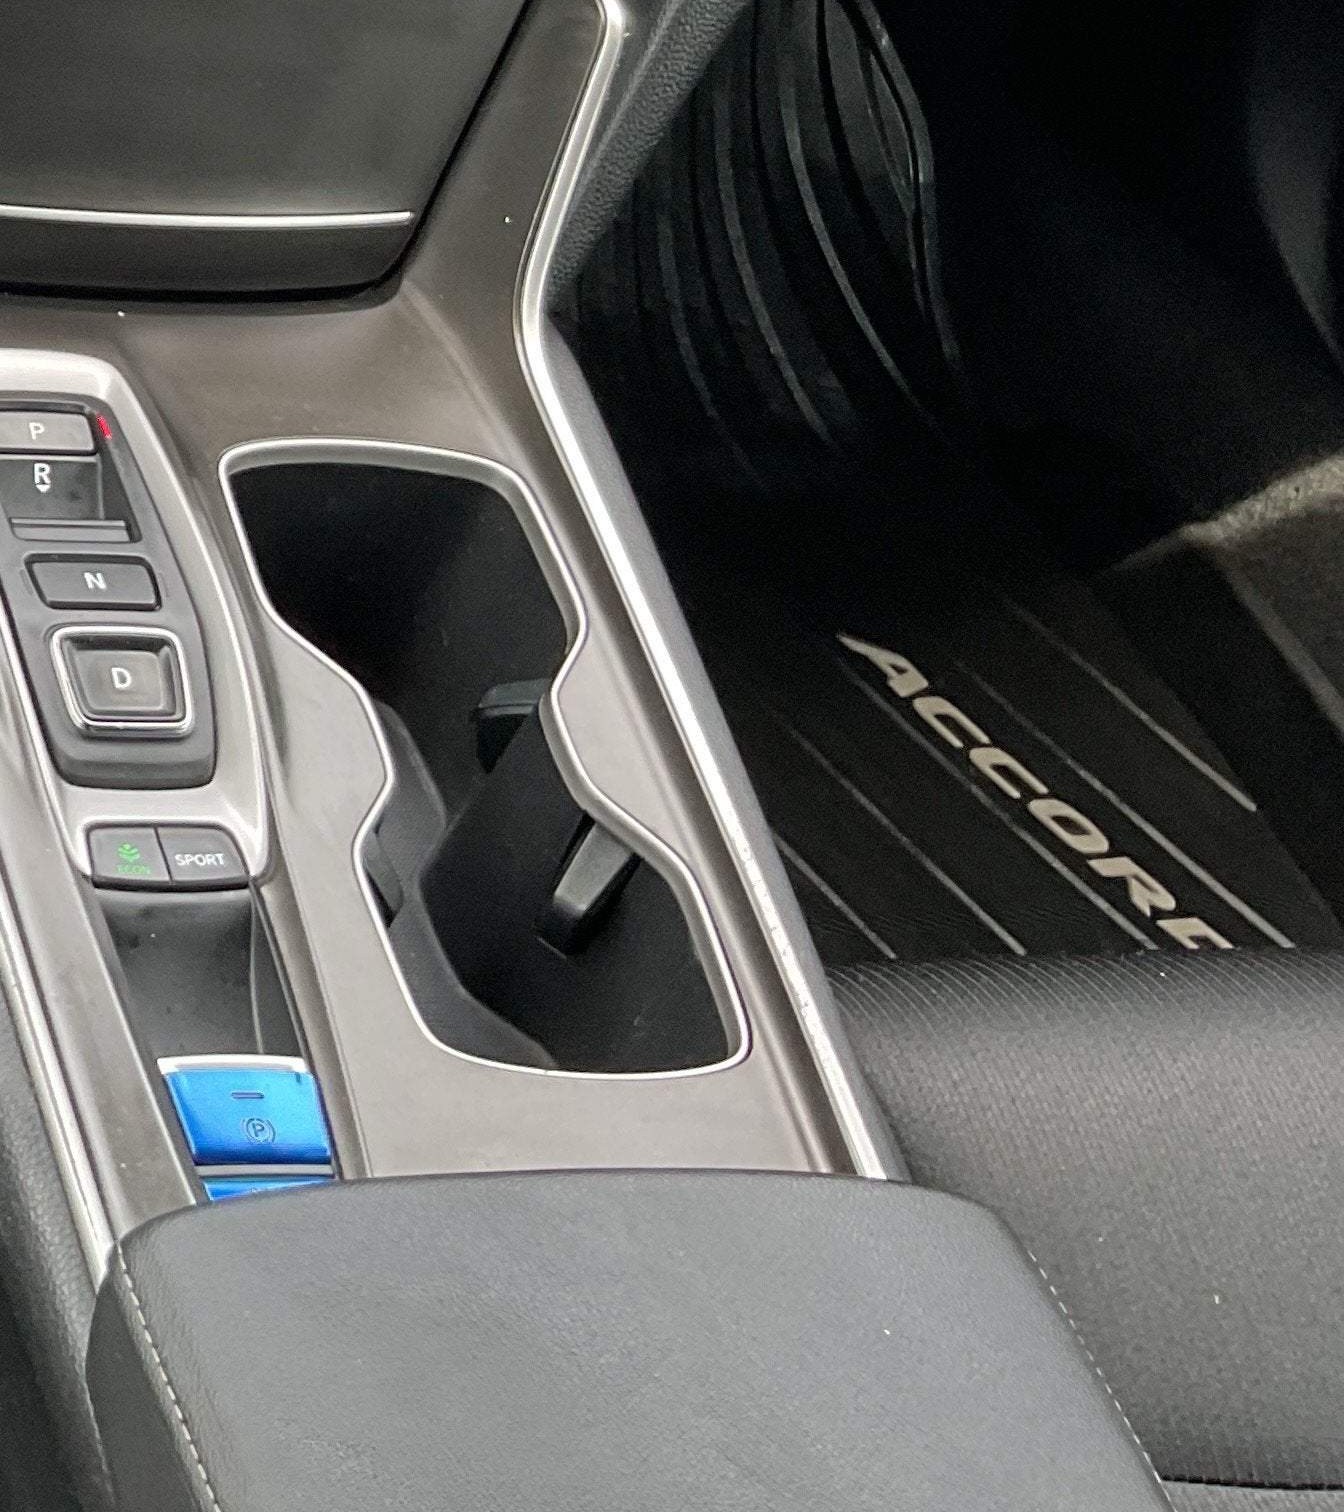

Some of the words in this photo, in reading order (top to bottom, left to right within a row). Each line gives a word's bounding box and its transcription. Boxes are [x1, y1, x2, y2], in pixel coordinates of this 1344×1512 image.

[28, 421, 46, 441] P
[33, 461, 51, 486] R
[84, 571, 107, 591] N
[111, 667, 132, 690] D
[174, 852, 226, 867] SPORT
